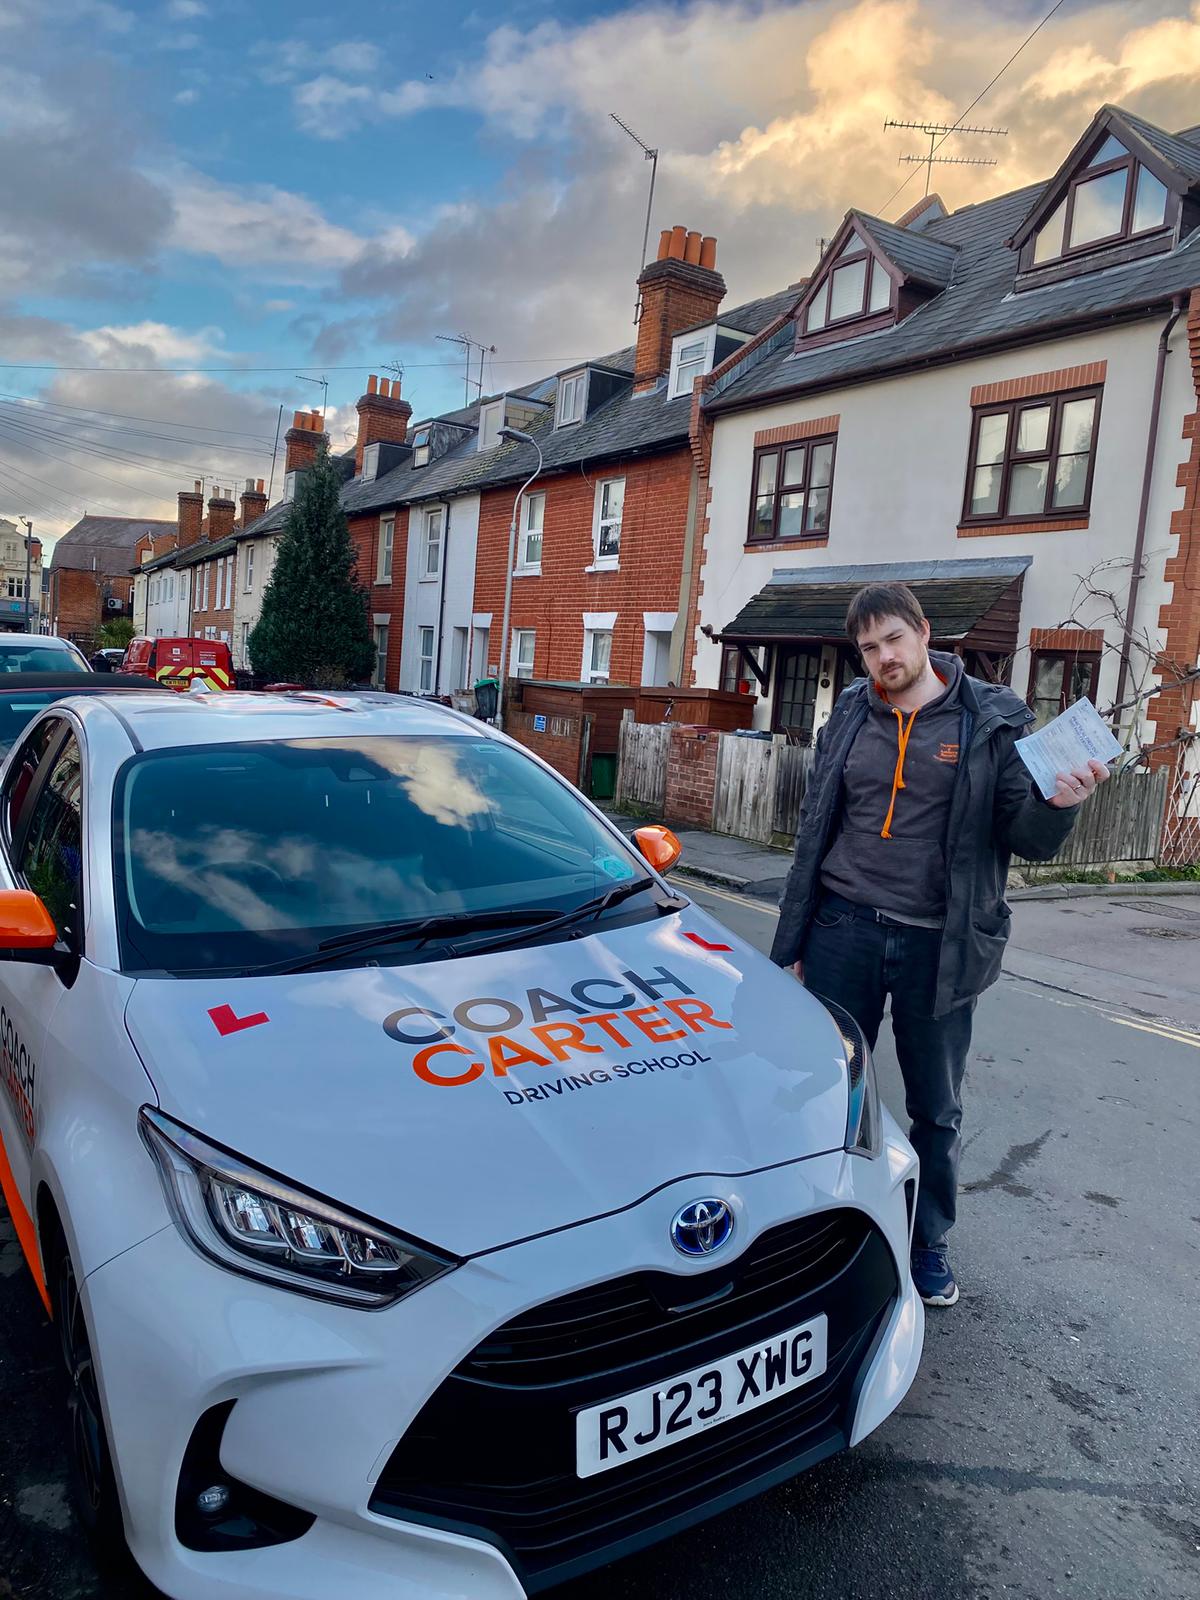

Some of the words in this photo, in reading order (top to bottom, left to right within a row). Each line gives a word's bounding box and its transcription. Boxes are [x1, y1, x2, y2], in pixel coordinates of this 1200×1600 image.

[682, 932, 735, 951] L
[207, 1003, 270, 1036] L
[383, 966, 695, 1044] COACH
[412, 998, 734, 1087] CARTER
[1, 1006, 35, 1108] COACH
[503, 1069, 611, 1105] DRIVING
[612, 1050, 711, 1078] SCHOOL
[599, 1370, 722, 1460] RJ23
[737, 1330, 813, 1405] XWG
